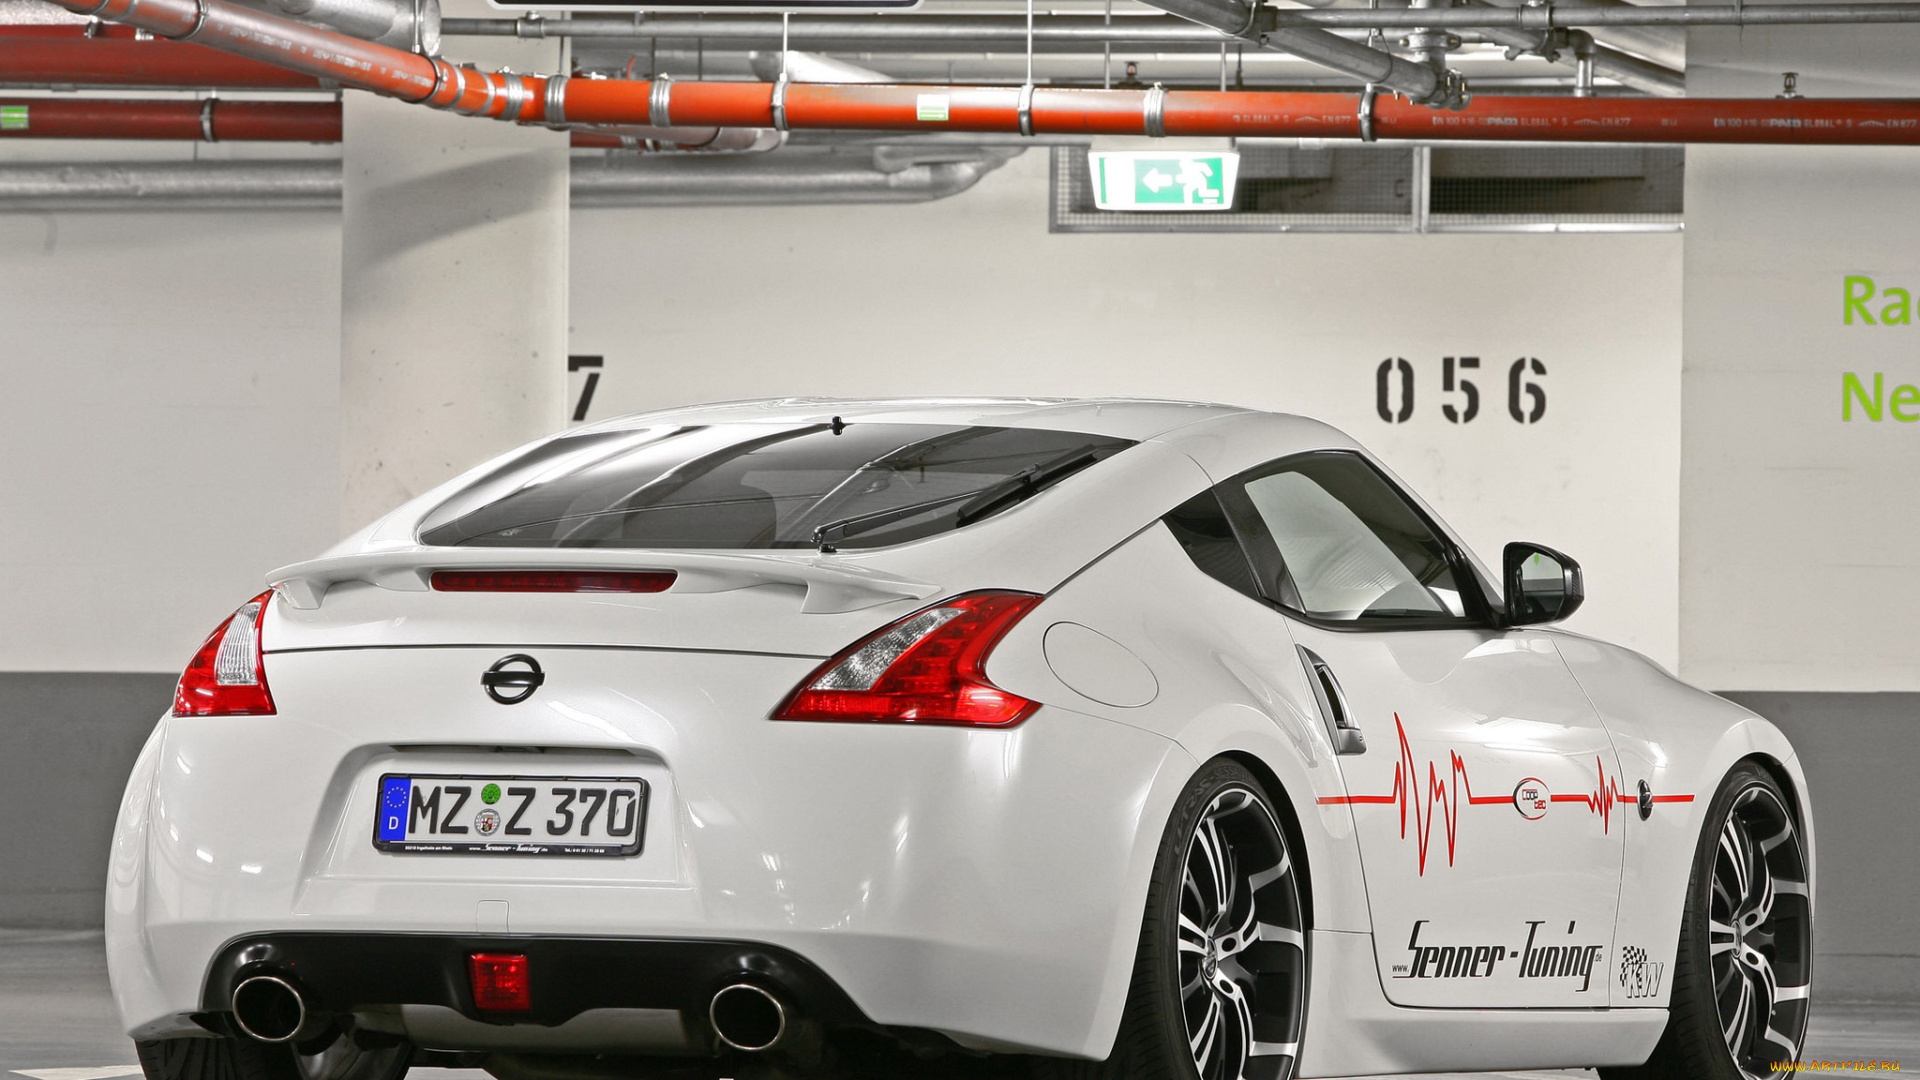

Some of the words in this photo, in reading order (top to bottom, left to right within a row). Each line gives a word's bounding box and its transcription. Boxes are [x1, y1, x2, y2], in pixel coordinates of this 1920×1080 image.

[1844, 275, 1920, 325] Ra
[388, 816, 399, 830] D
[408, 785, 472, 834] MZ
[504, 787, 536, 836] Z
[546, 787, 636, 837] 370
[1626, 961, 1664, 998] KW
